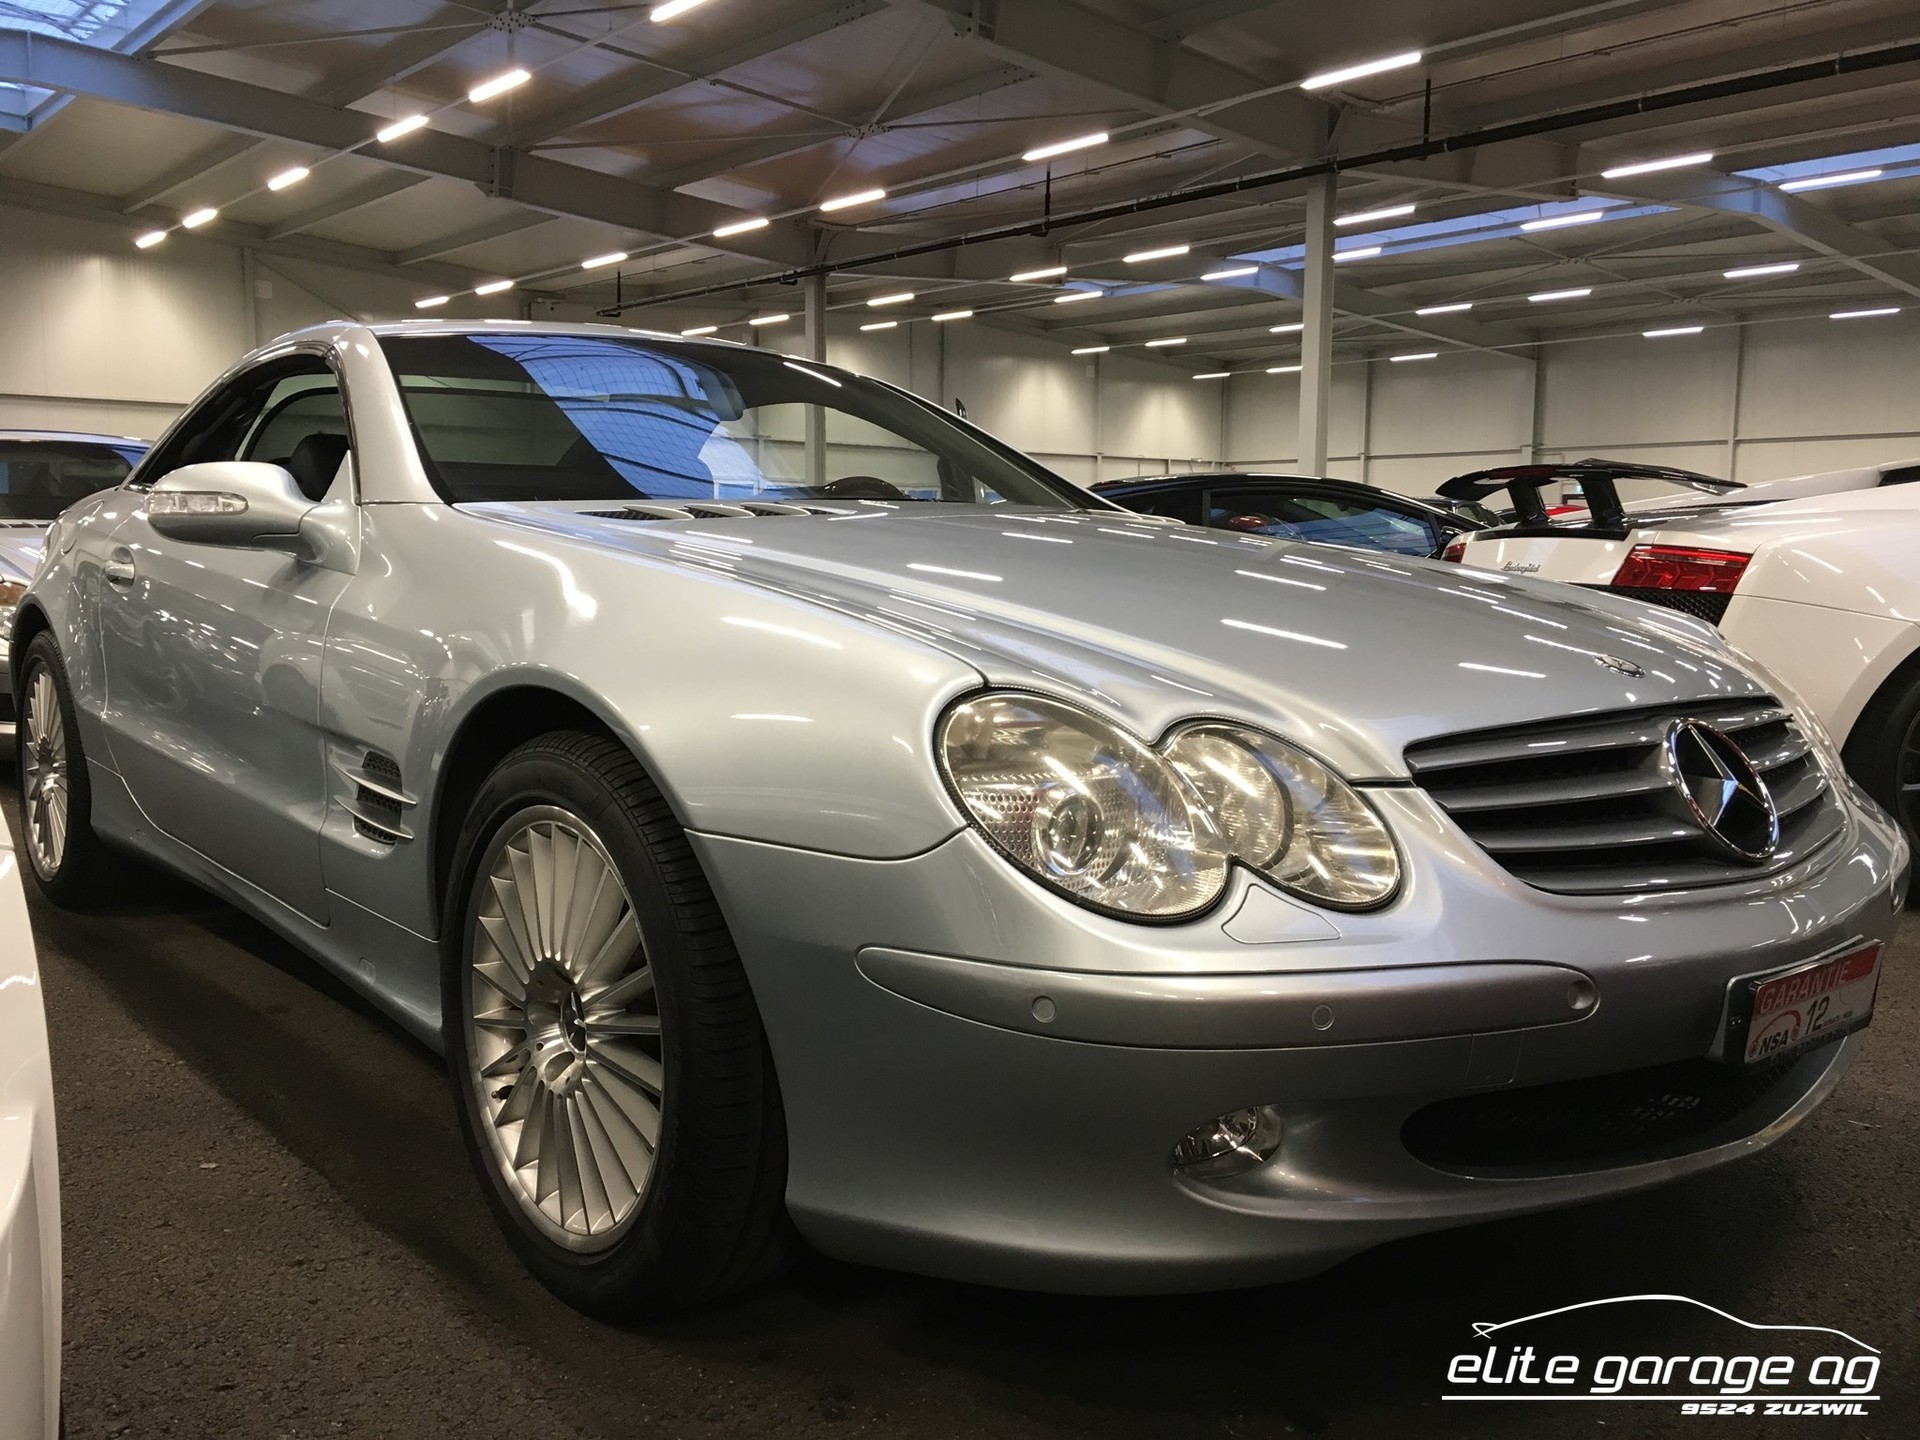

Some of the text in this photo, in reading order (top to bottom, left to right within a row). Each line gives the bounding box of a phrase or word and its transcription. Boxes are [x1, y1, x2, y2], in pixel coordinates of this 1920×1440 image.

[1760, 961, 1850, 1012] GARANTIE
[1806, 996, 1830, 1034] 12
[1759, 1029, 1788, 1055] NSA
